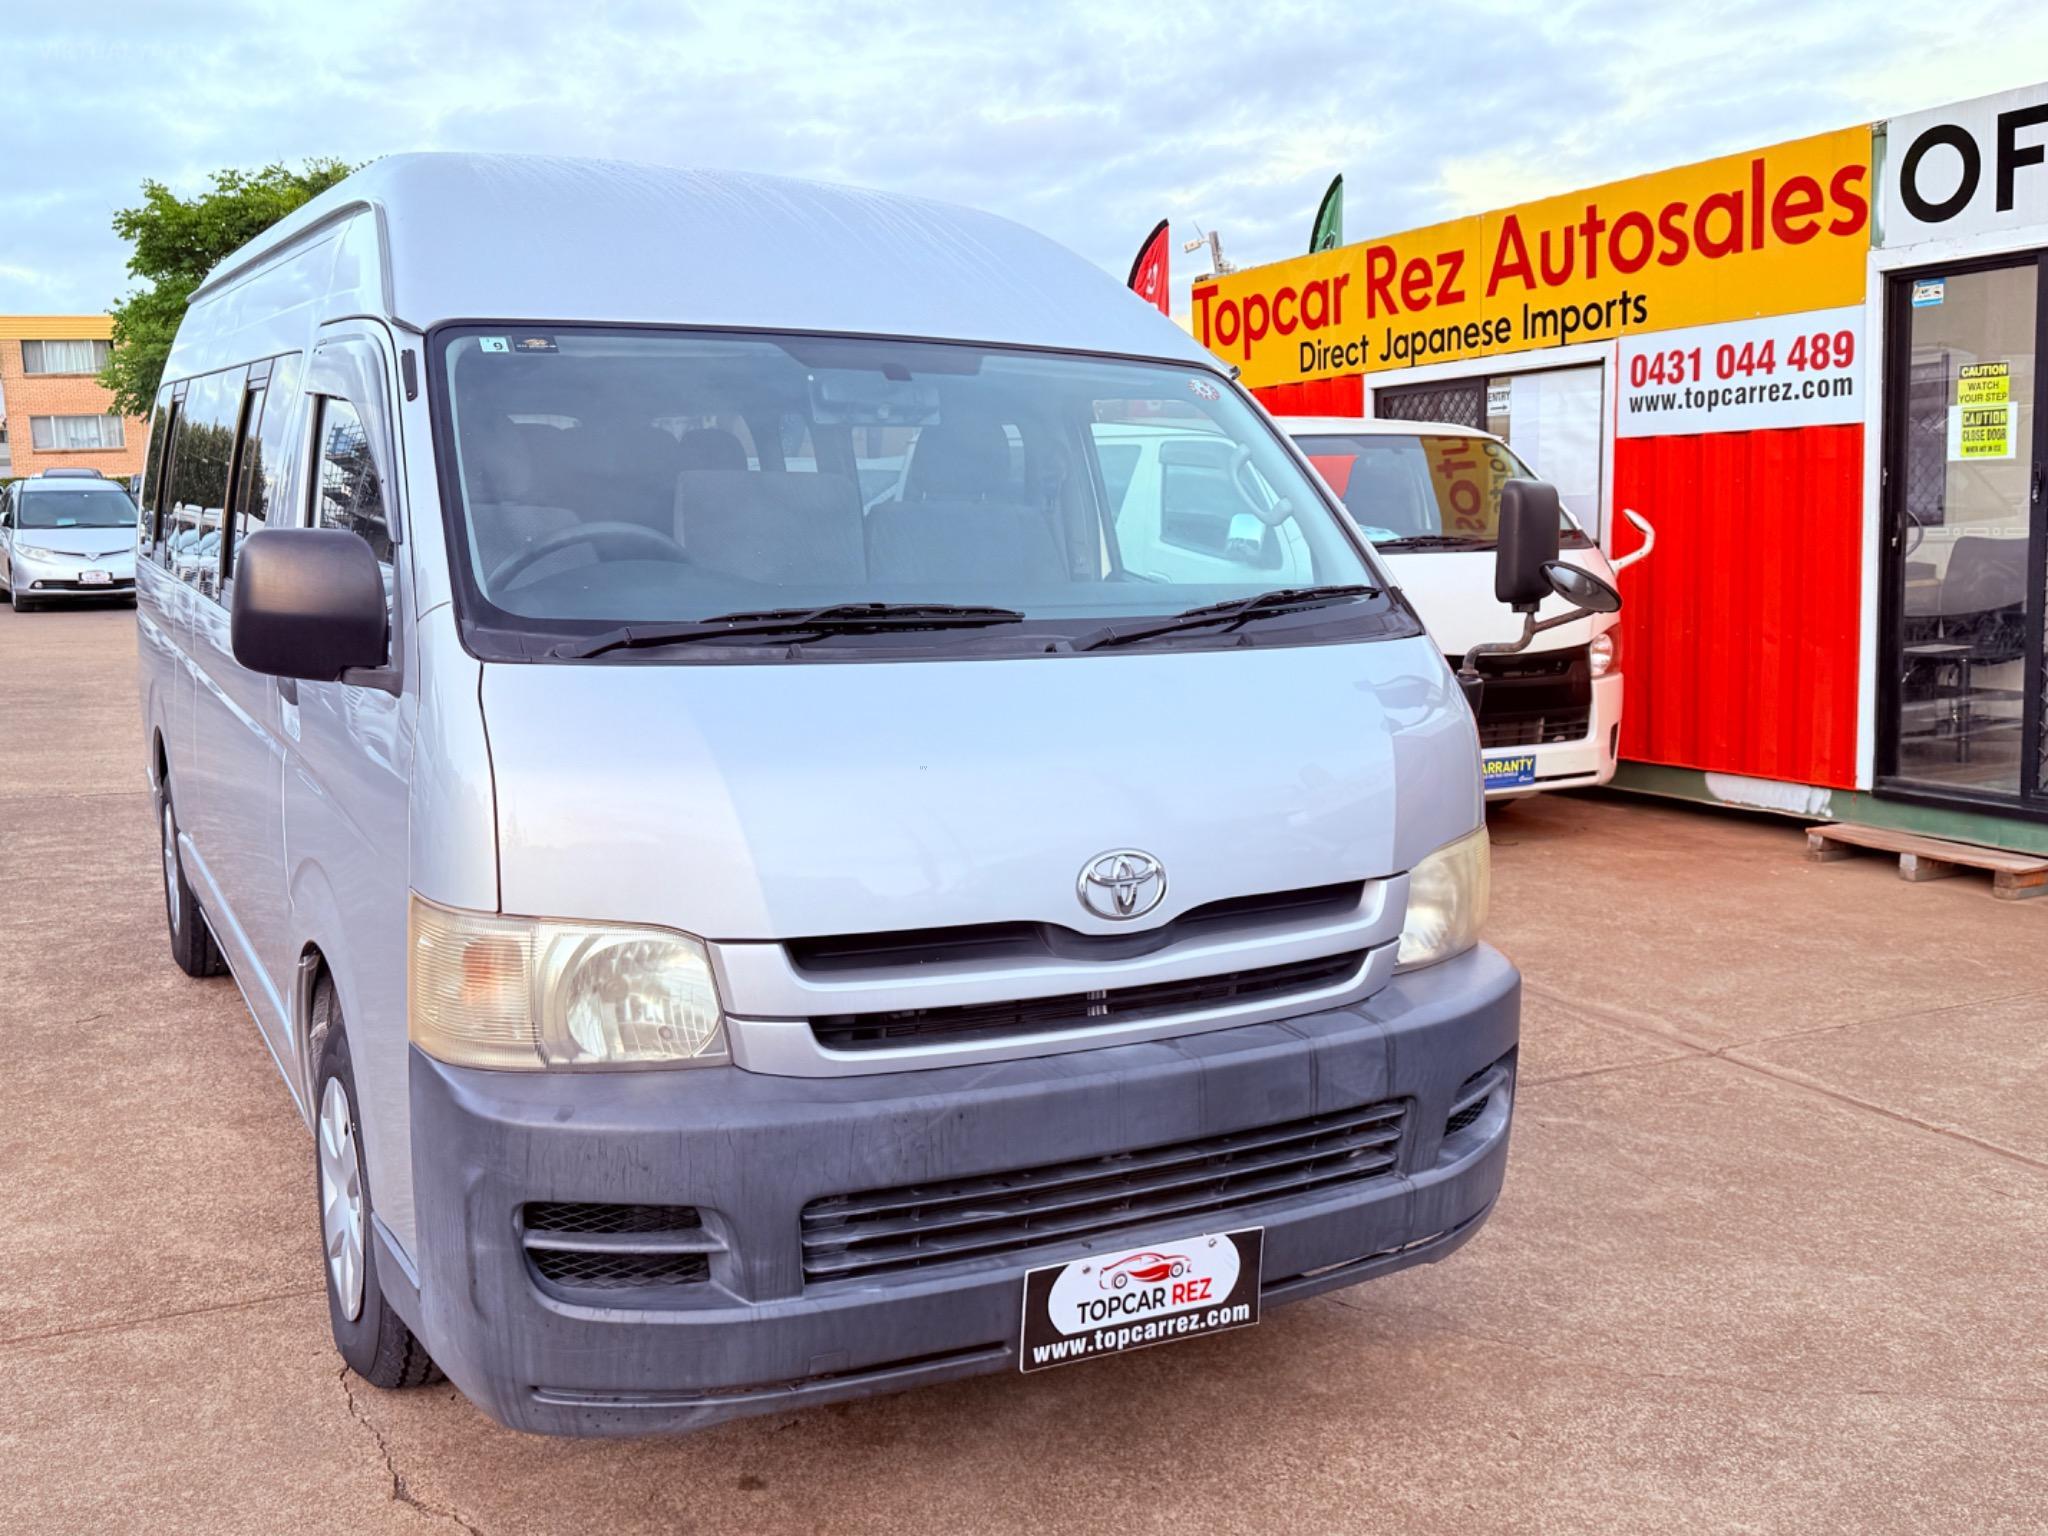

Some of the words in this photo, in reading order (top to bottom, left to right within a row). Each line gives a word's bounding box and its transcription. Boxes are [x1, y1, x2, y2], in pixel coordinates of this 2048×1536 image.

[1900, 104, 2048, 223] OF
[1192, 274, 1350, 361] Topcar
[1366, 245, 1466, 320] Rez
[1486, 158, 1868, 298] Autosales
[1300, 335, 1369, 373] Direct
[1379, 318, 1511, 369] Japanese
[1523, 291, 1648, 341] Imports
[1631, 348, 1701, 388] 0431
[1716, 340, 1775, 380] 044
[1787, 331, 1855, 372] 489
[1961, 364, 2008, 377] CAUTION
[1629, 376, 1853, 413] www.topcarrez.com
[1959, 393, 1983, 403] YOUR
[1985, 392, 2008, 401] STEP
[1967, 381, 2000, 391] WATCH
[1963, 411, 2007, 426] CAUTION
[1077, 1287, 1166, 1324] TOPCAR
[1172, 1277, 1213, 1306] REZ
[1033, 1303, 1250, 1364] www.topcarrez.com
